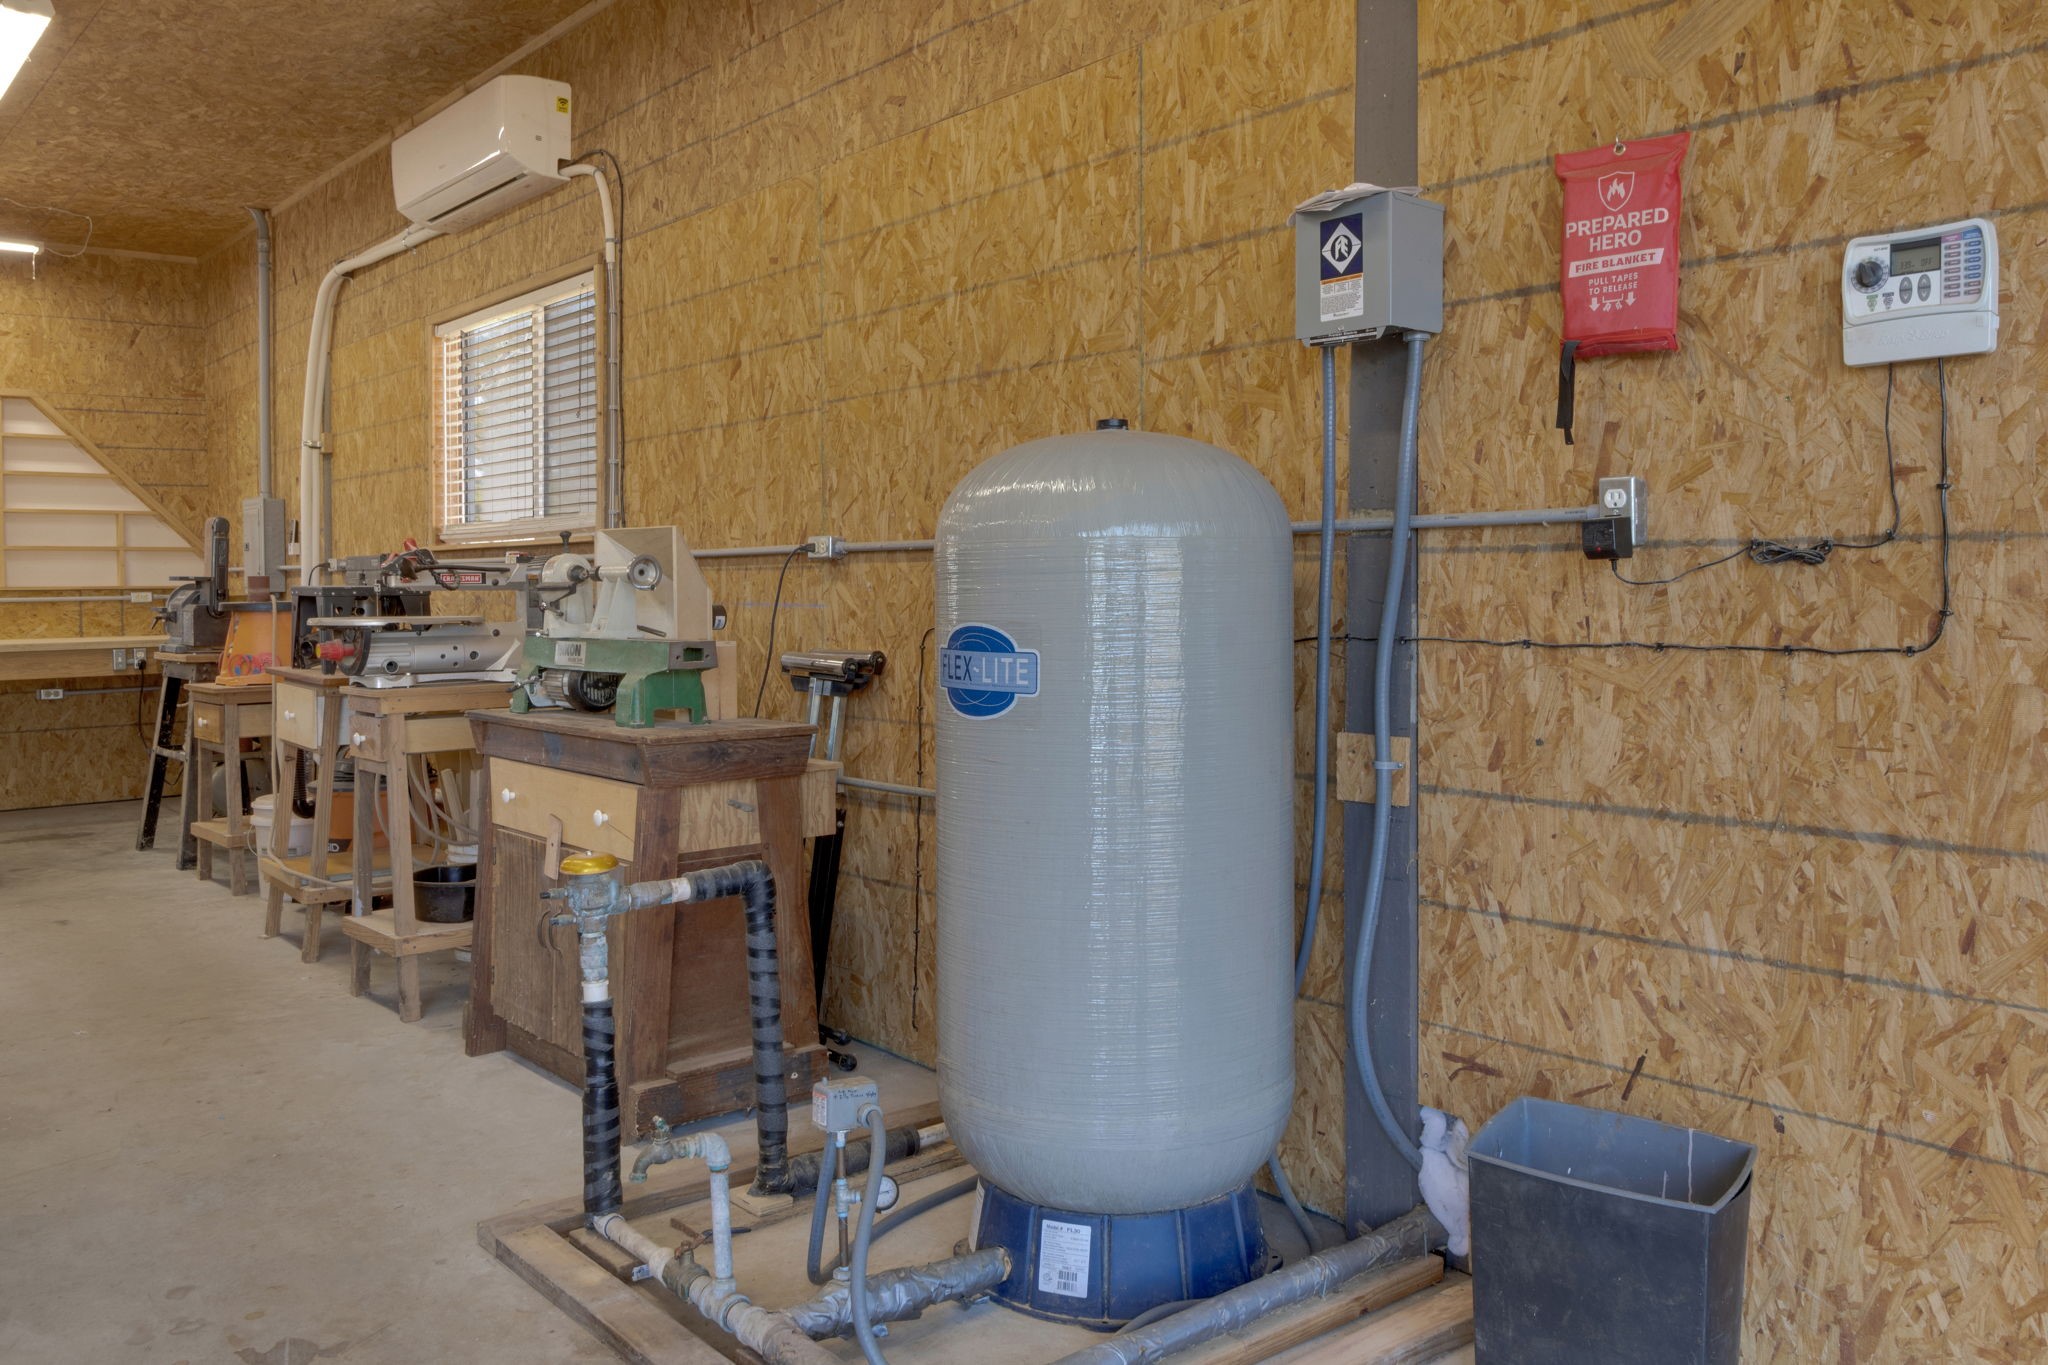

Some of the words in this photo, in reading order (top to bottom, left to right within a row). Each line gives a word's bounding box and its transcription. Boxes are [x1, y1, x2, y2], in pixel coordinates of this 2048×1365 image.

[1566, 208, 1669, 238] PREPARED
[1589, 229, 1642, 253] HERO
[1575, 260, 1599, 274] FIRE
[1601, 252, 1656, 269] BLANKET
[1588, 276, 1609, 287] PULL
[1611, 272, 1638, 283] TAPES
[1588, 286, 1600, 295] TO
[1602, 281, 1638, 294] RELEASE
